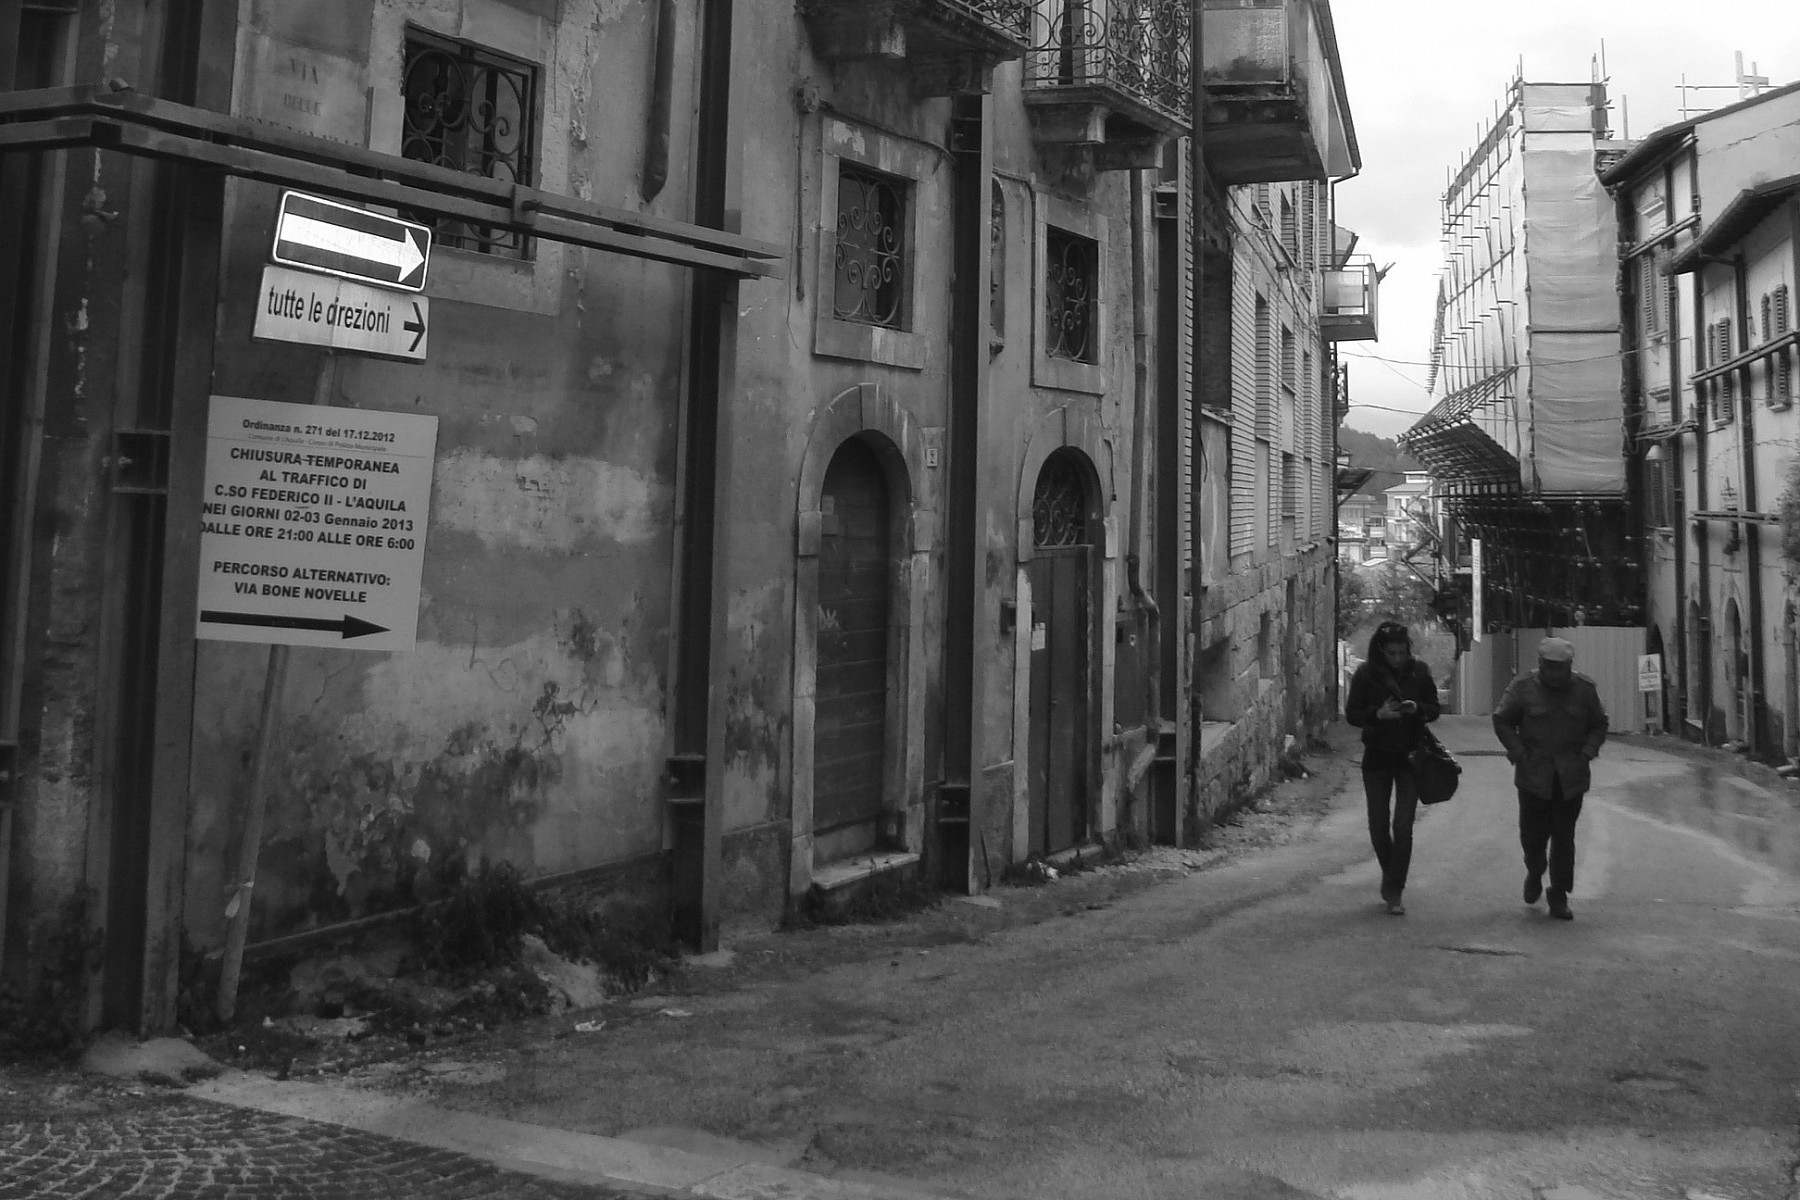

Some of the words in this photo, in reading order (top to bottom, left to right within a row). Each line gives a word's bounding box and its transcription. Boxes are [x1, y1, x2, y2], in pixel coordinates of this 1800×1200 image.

[267, 285, 304, 320] tutte
[308, 292, 322, 323] le
[243, 419, 291, 433] Ordinanza
[294, 424, 302, 434] n.
[305, 425, 323, 436] 271
[326, 427, 341, 438] del
[343, 429, 395, 443] 17.12.2012
[231, 447, 302, 465] CHIUSURA
[306, 454, 400, 474] TEMPORANEA
[260, 470, 278, 482] AL
[282, 471, 348, 488] TRAFFICO
[354, 478, 367, 490] DI
[215, 485, 247, 498] C.SO
[251, 488, 320, 504] FEDERICO
[324, 495, 333, 506] II
[345, 496, 406, 512] L'AQUILA
[203, 503, 226, 516] NEI
[231, 504, 280, 521] GIORNI
[284, 510, 320, 523] 02-03
[324, 513, 378, 529] Gennaio
[382, 518, 413, 531] 2013
[245, 525, 273, 539] ORE
[277, 528, 313, 543] 21:00
[318, 532, 351, 545] ALLE
[356, 535, 383, 548] ORE
[387, 537, 415, 551] 6:00
[213, 561, 288, 578] PERCORSO
[292, 567, 391, 586] ALTERNATIVO:
[234, 582, 257, 595] VIA
[262, 584, 300, 598] BONE
[305, 588, 367, 603] NOVELLE
